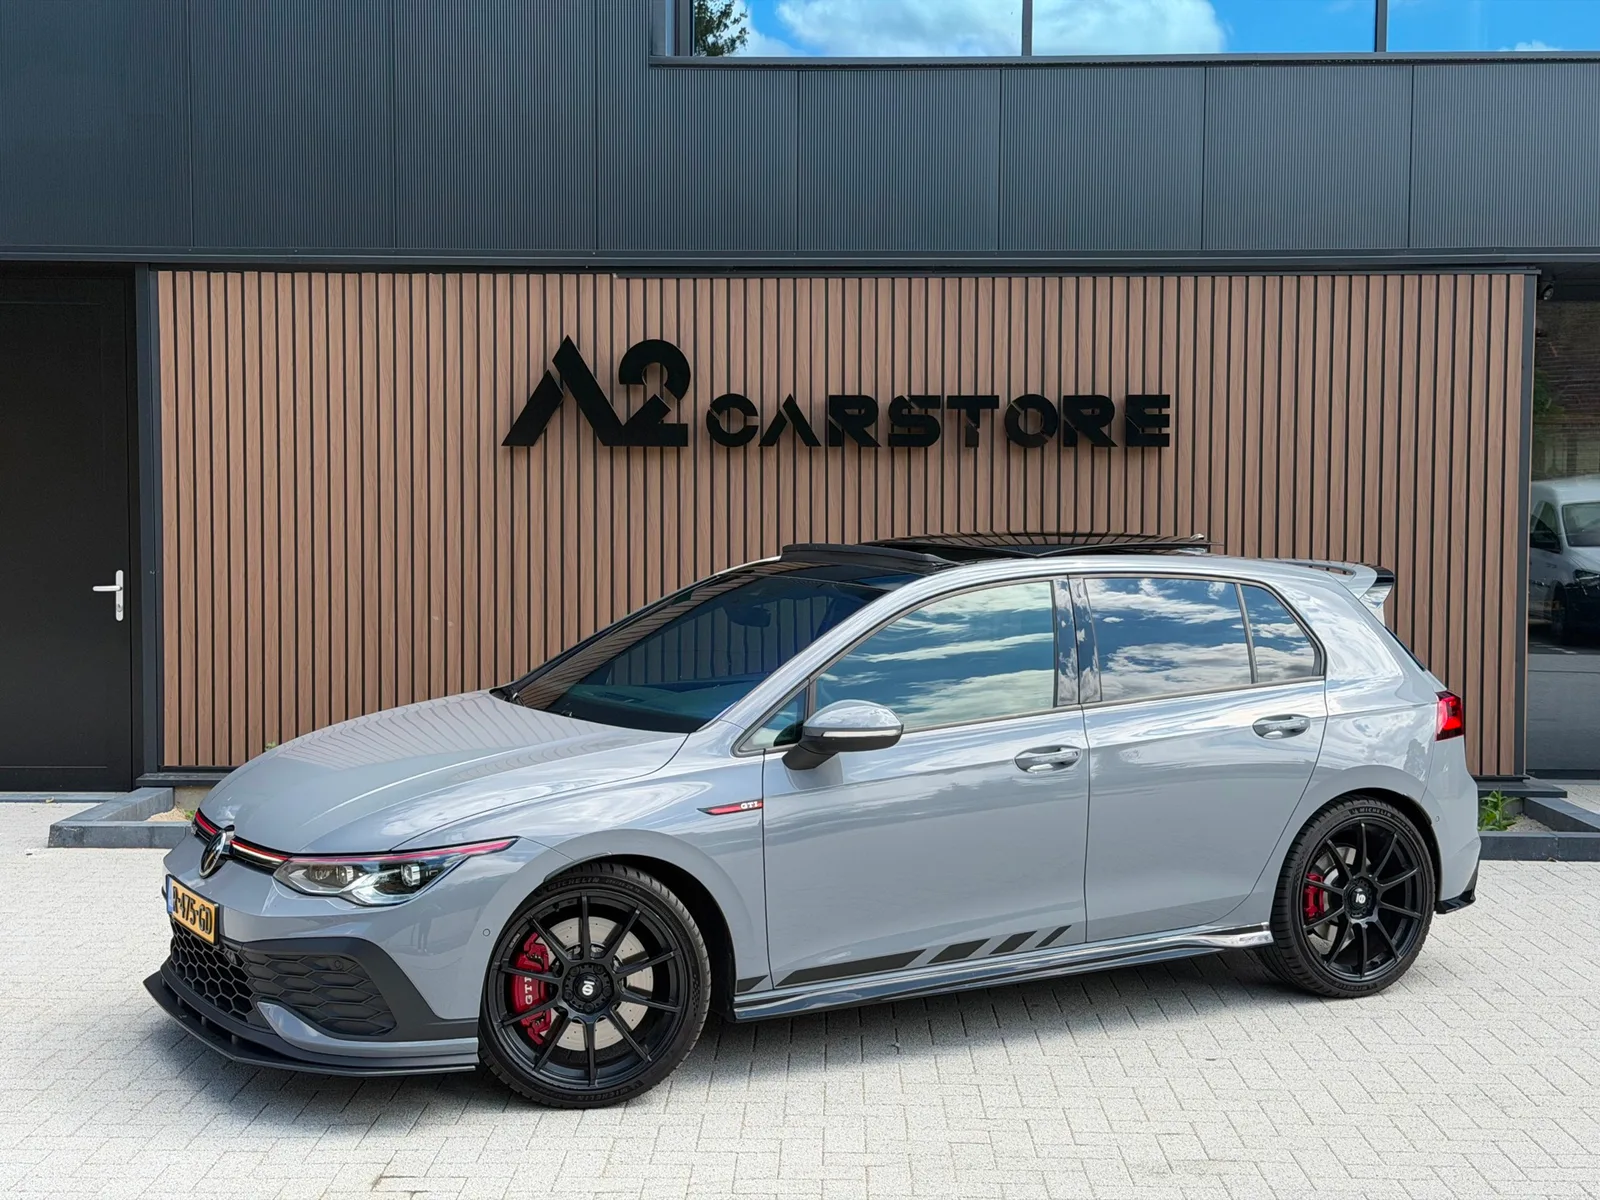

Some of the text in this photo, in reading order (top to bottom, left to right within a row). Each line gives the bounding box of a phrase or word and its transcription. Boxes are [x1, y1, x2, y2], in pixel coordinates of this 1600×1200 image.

[501, 334, 1170, 447] A2 CARSTORE
[740, 801, 759, 810] GTI
[1359, 806, 1392, 818] MICHELIN
[547, 876, 600, 892] MICHELIN
[524, 976, 533, 1005] GTI
[576, 1087, 629, 1101] MICHELIN
